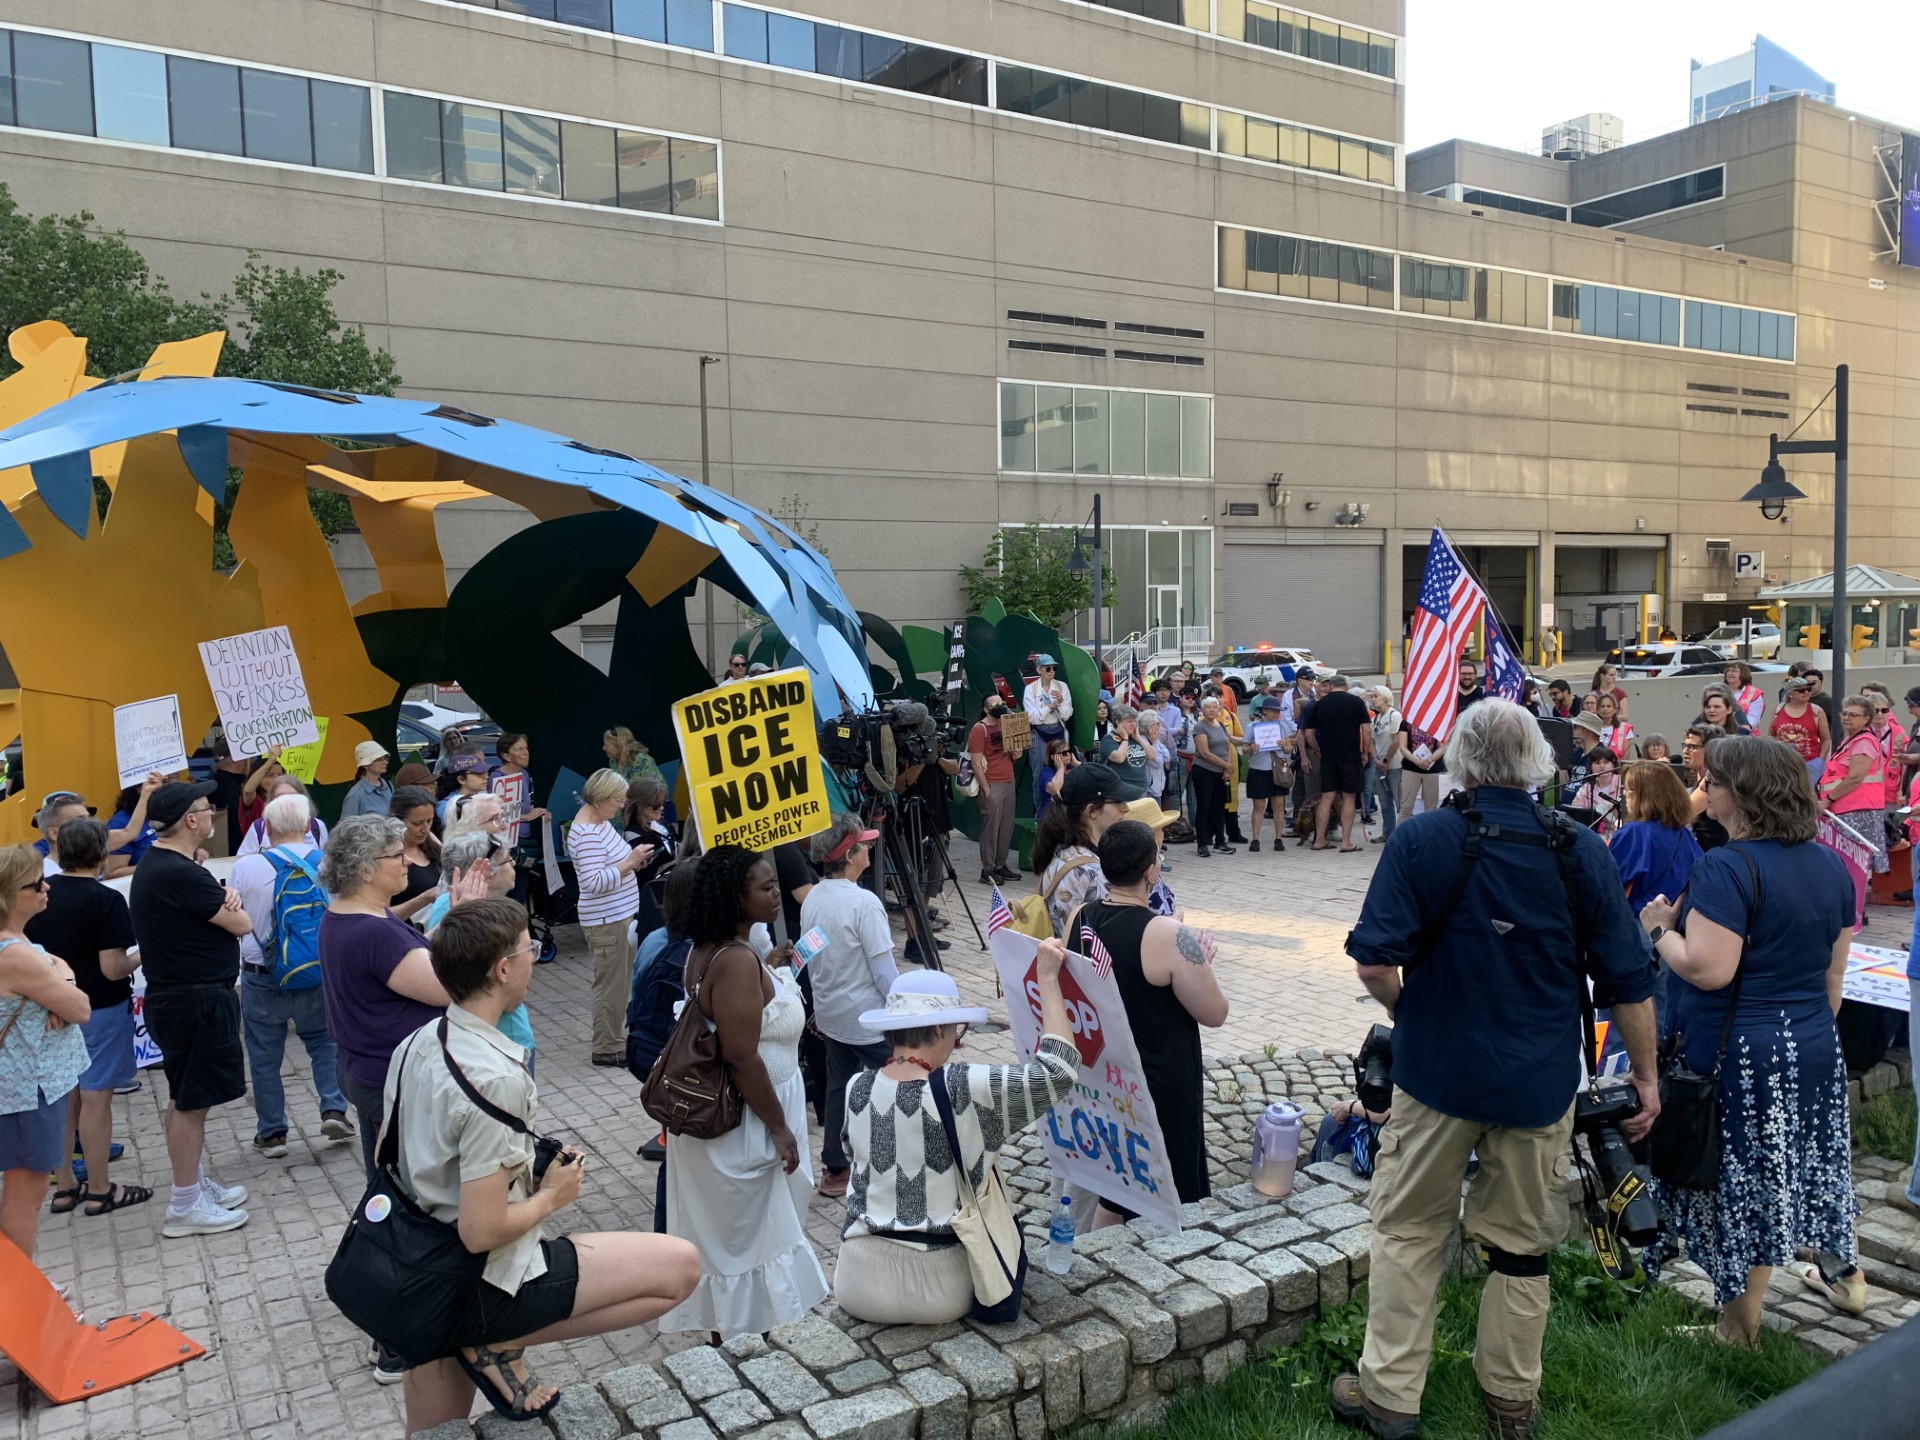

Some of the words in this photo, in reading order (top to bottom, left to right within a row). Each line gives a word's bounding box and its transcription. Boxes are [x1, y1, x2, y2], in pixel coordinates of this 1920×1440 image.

[1737, 554, 1752, 573] P
[205, 629, 291, 667] DETENTION
[218, 653, 293, 689] WITHOUT
[213, 690, 250, 716] DUE
[246, 676, 306, 708] PROCESS
[250, 707, 265, 718] IS
[267, 703, 278, 714] A
[685, 681, 806, 734] DISBAND
[225, 706, 313, 743] CONCENTRATION
[239, 728, 298, 756] CAMP
[286, 751, 307, 765] EVIL
[703, 712, 795, 777] ICE
[493, 775, 523, 803] GET
[711, 755, 809, 825] NOW
[714, 816, 771, 848] PEOPLES
[773, 800, 821, 826] POWER
[736, 819, 803, 851] ASSEMBLY
[1025, 982, 1101, 1040] SOP
[1105, 1060, 1143, 1102] the
[1073, 1082, 1107, 1105] me
[1112, 1096, 1140, 1126] of
[1046, 1105, 1160, 1195] LOVE
[1622, 1176, 1640, 1195] Nikon
[1596, 1226, 1606, 1250] Nikon
